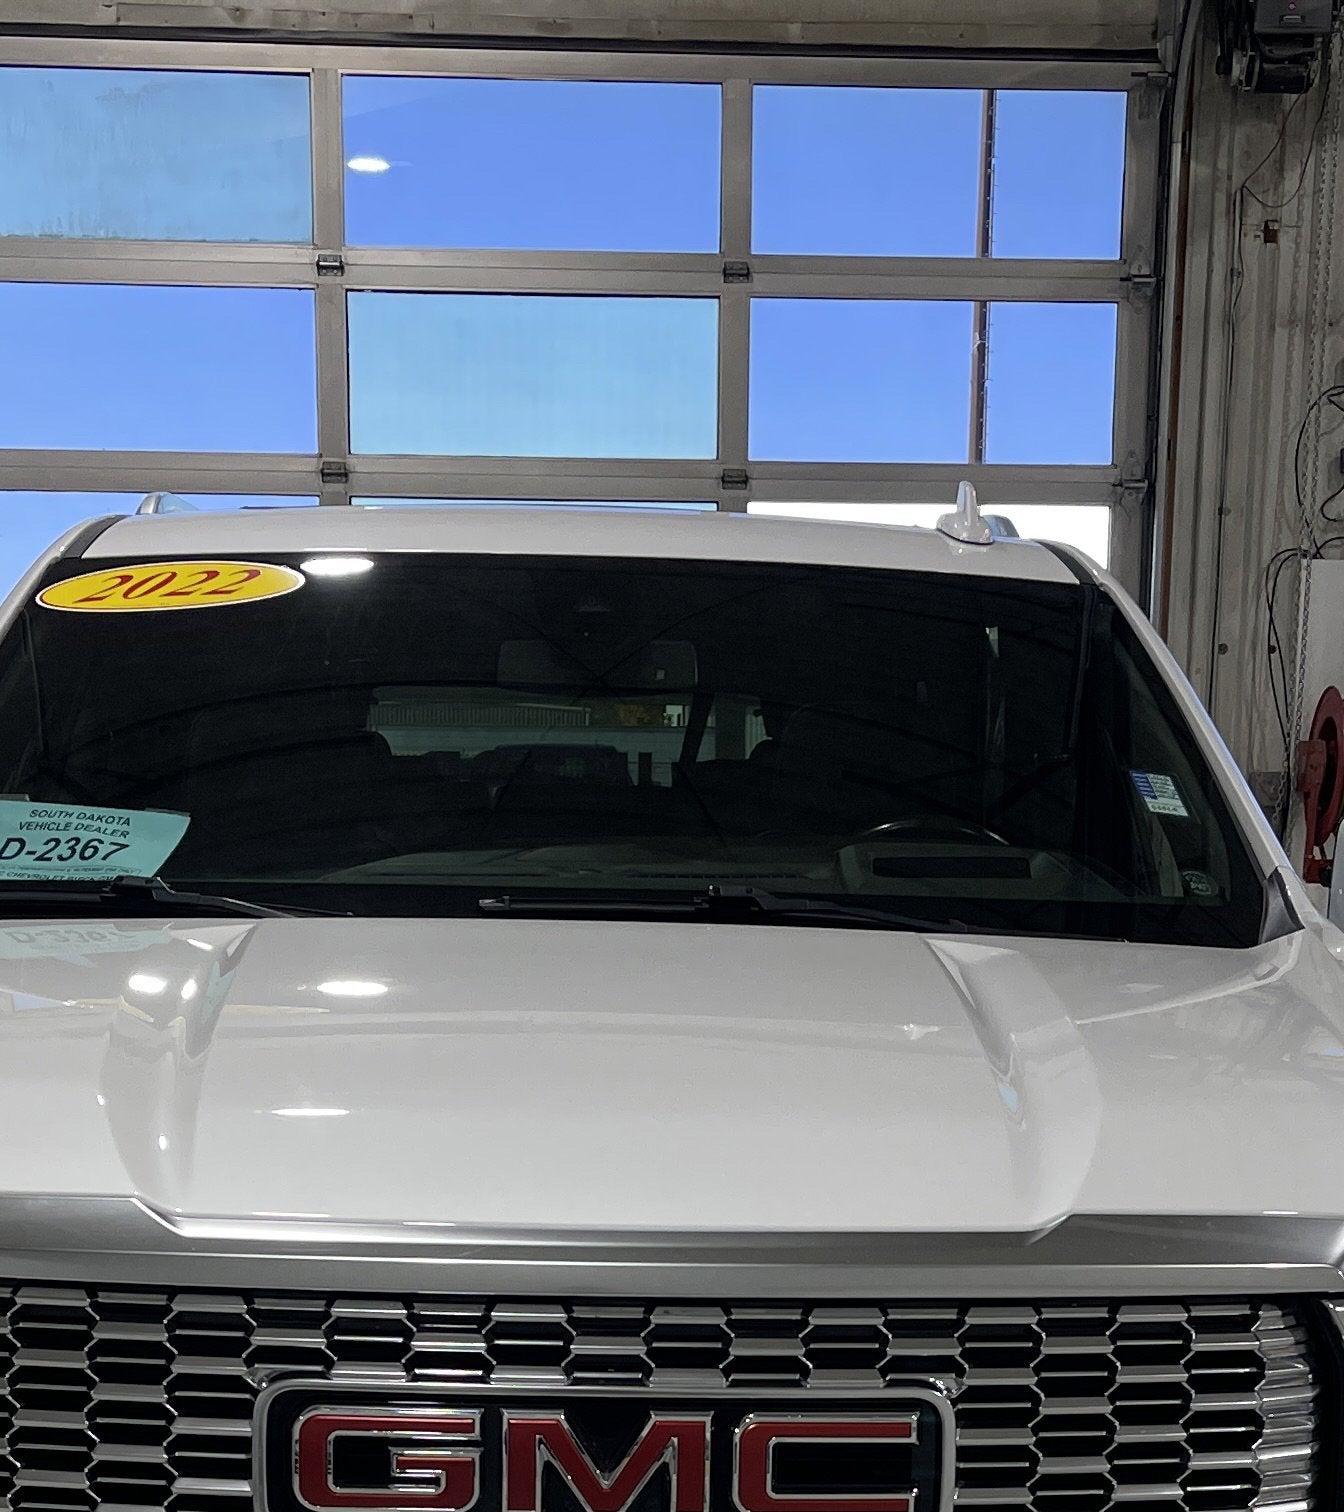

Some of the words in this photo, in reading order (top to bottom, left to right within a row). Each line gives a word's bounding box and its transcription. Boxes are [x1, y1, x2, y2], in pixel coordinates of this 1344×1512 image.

[72, 569, 261, 604] 2022
[29, 809, 75, 820] SOUTH
[76, 812, 131, 827] DAKOTA
[19, 821, 72, 831] VEHICLE
[74, 823, 130, 838] DEALER
